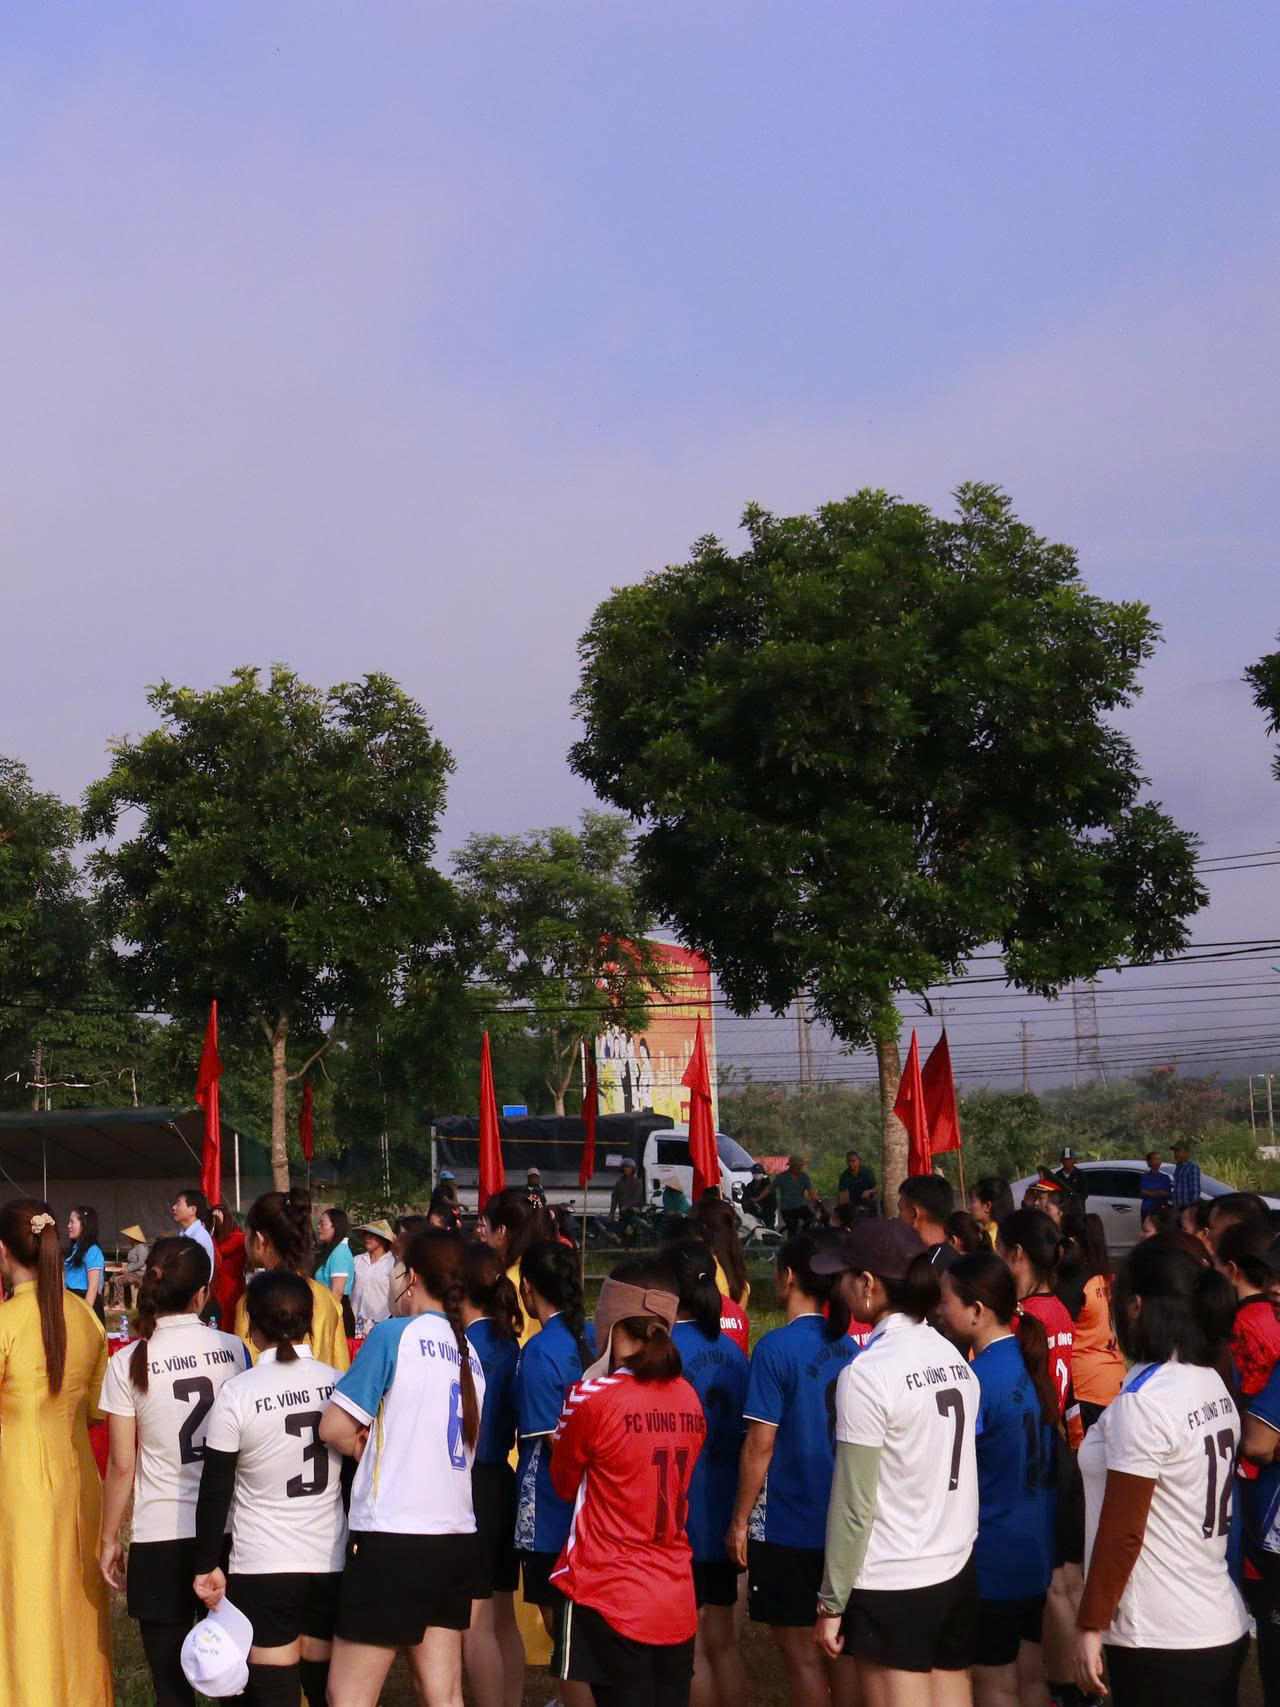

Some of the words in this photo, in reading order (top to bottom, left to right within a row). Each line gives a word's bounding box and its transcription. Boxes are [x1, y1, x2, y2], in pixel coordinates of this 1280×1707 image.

[420, 1339, 435, 1357] FC
[738, 1319, 743, 1330] 1
[203, 1348, 235, 1365] TRÒN
[316, 1382, 336, 1400] TR
[173, 1376, 214, 1465] 2
[625, 1414, 642, 1433] FC
[645, 1409, 676, 1432] VŨNG
[935, 1388, 965, 1491] 7
[285, 1411, 329, 1498] 3
[651, 1447, 688, 1544] 11
[1202, 1428, 1235, 1539] 12
